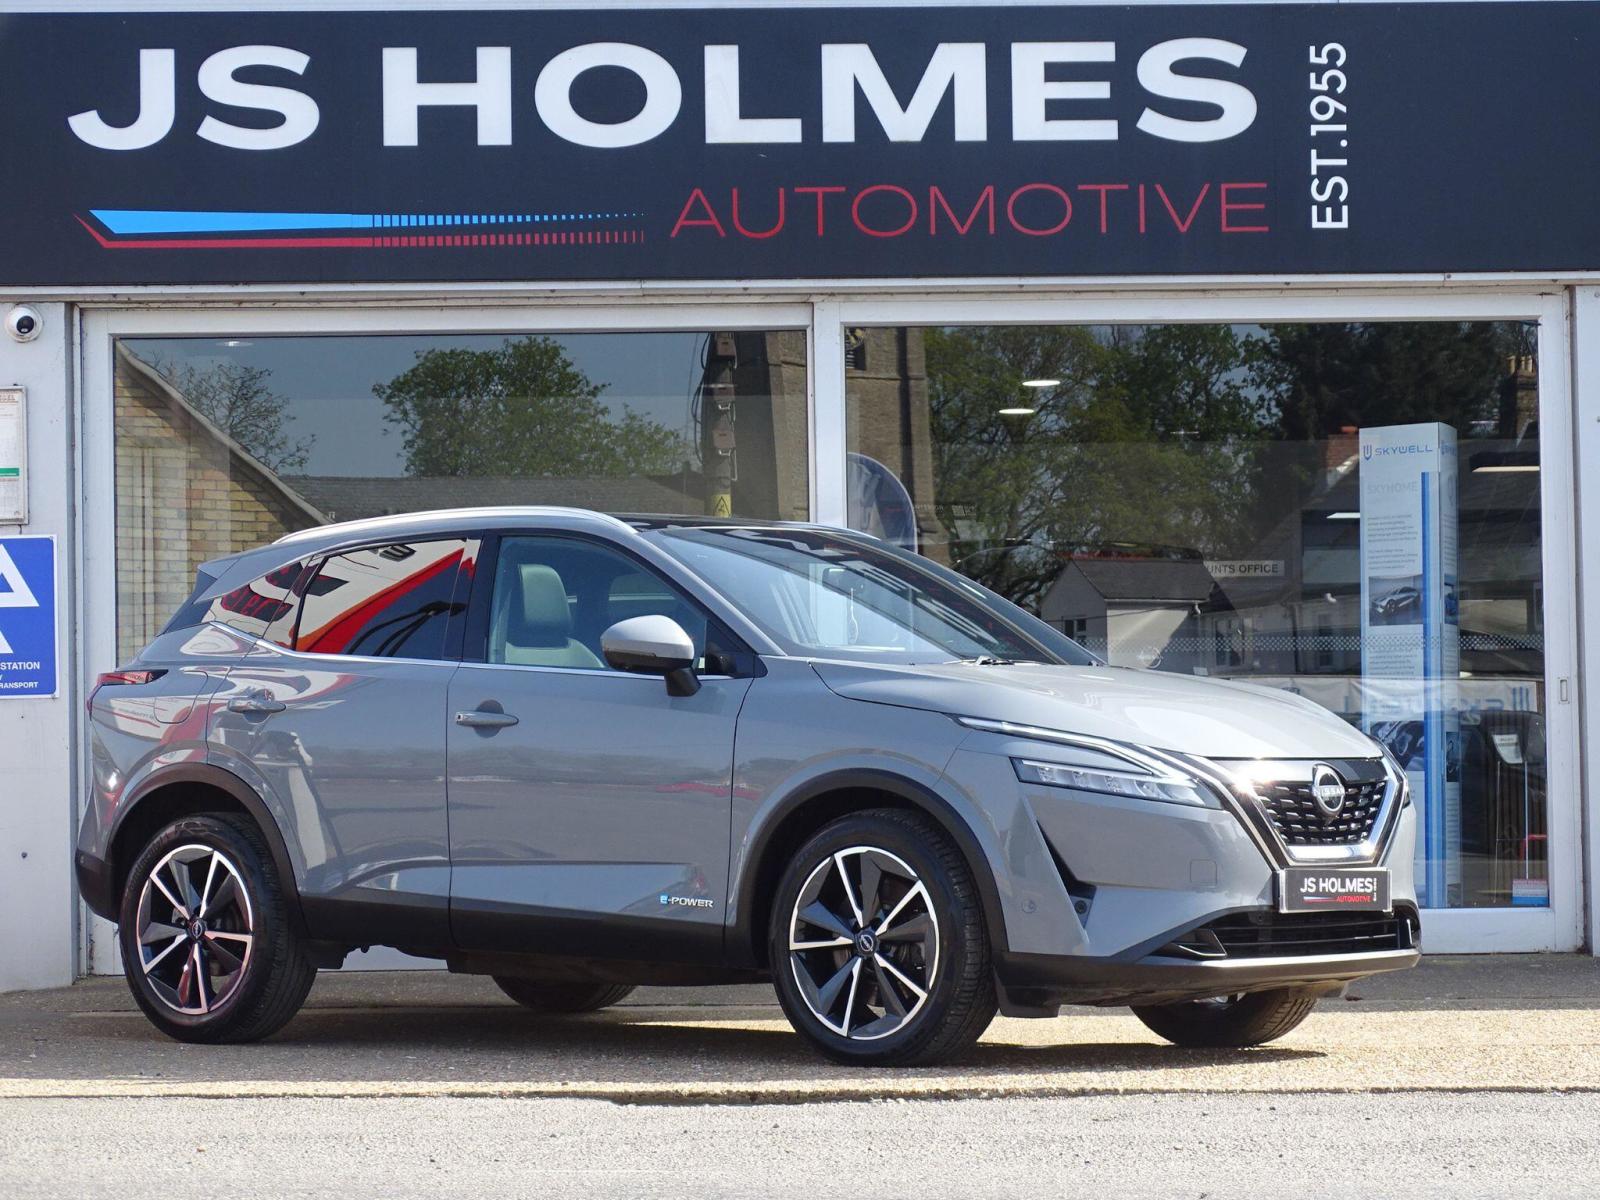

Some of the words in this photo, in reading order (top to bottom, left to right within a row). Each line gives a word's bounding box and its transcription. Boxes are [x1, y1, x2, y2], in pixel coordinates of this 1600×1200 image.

[67, 45, 321, 151] JS
[382, 37, 1258, 148] HOLMES
[670, 182, 1269, 239] AUTOMOTIVE
[1375, 445, 1433, 456] SKYWELL
[1239, 564, 1279, 573] OFFICE
[0, 661, 40, 670] STATION
[1300, 878, 1316, 893] JS
[1319, 877, 1373, 893] HOLMES
